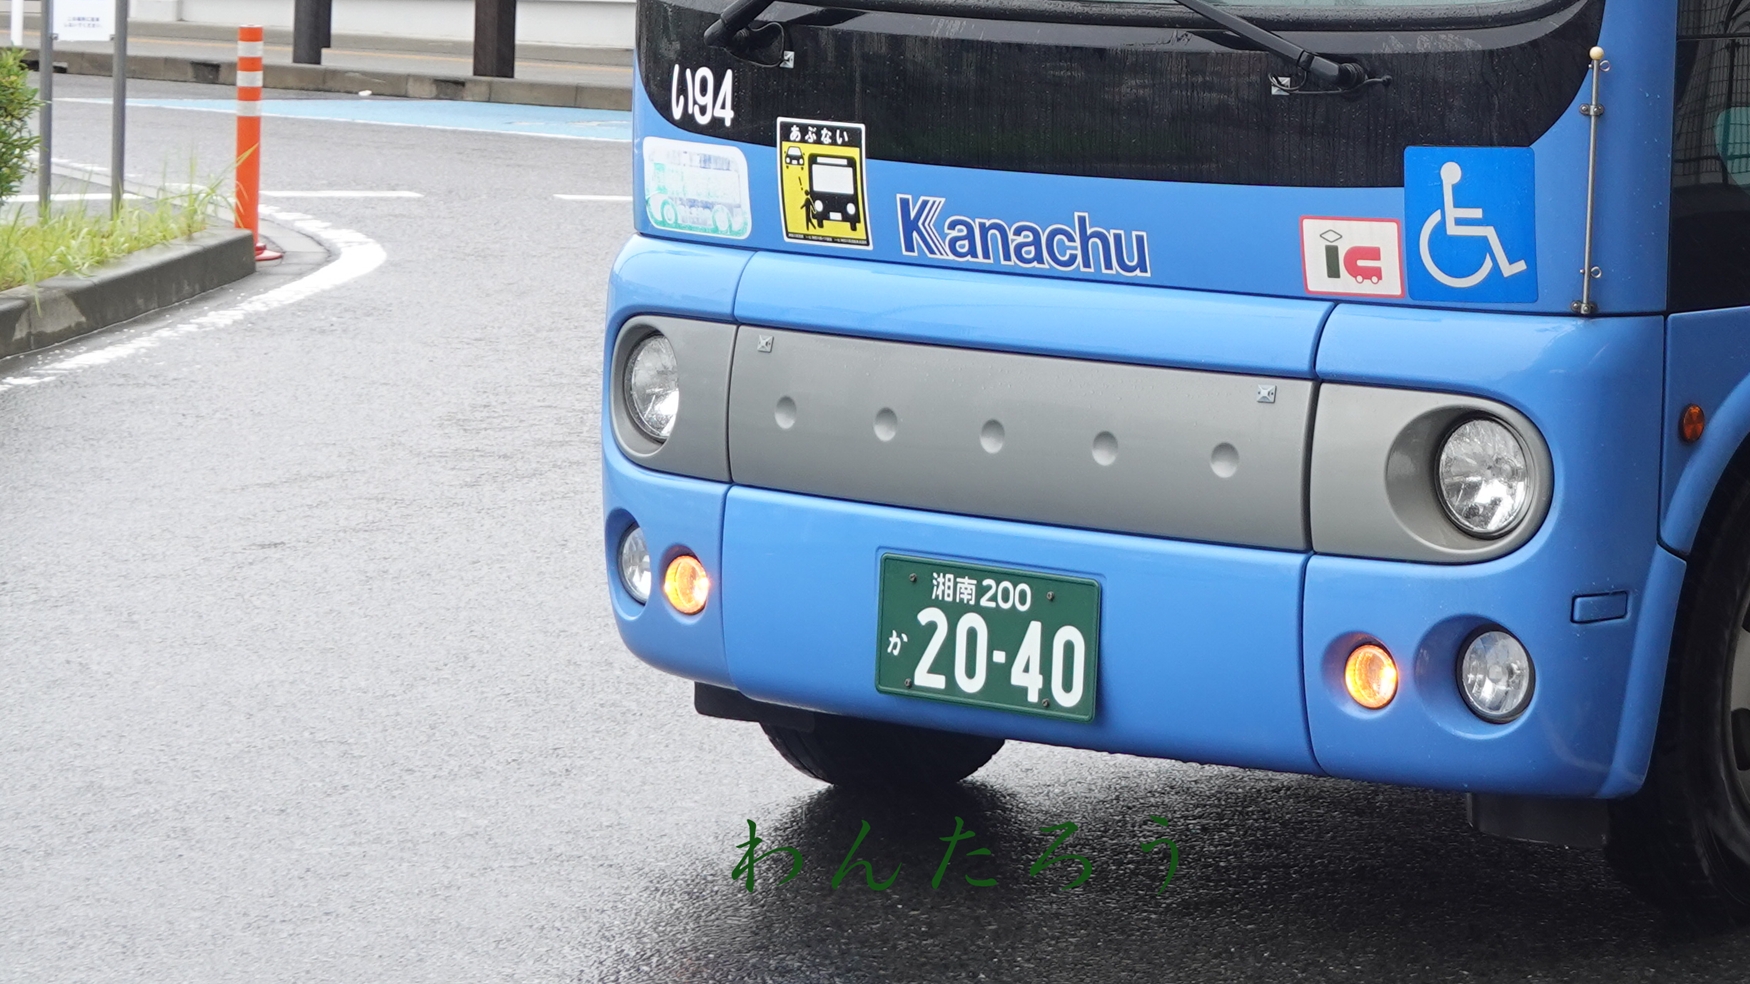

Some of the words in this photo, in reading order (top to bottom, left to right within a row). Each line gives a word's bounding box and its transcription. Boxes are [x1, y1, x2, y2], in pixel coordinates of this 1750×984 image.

[671, 64, 735, 127] い94
[788, 124, 850, 145] あぶない
[896, 193, 1151, 277] Kanachu
[931, 572, 977, 606] 湘南
[980, 578, 1032, 612] 200
[887, 629, 908, 656] か
[913, 606, 1086, 708] 20-40
